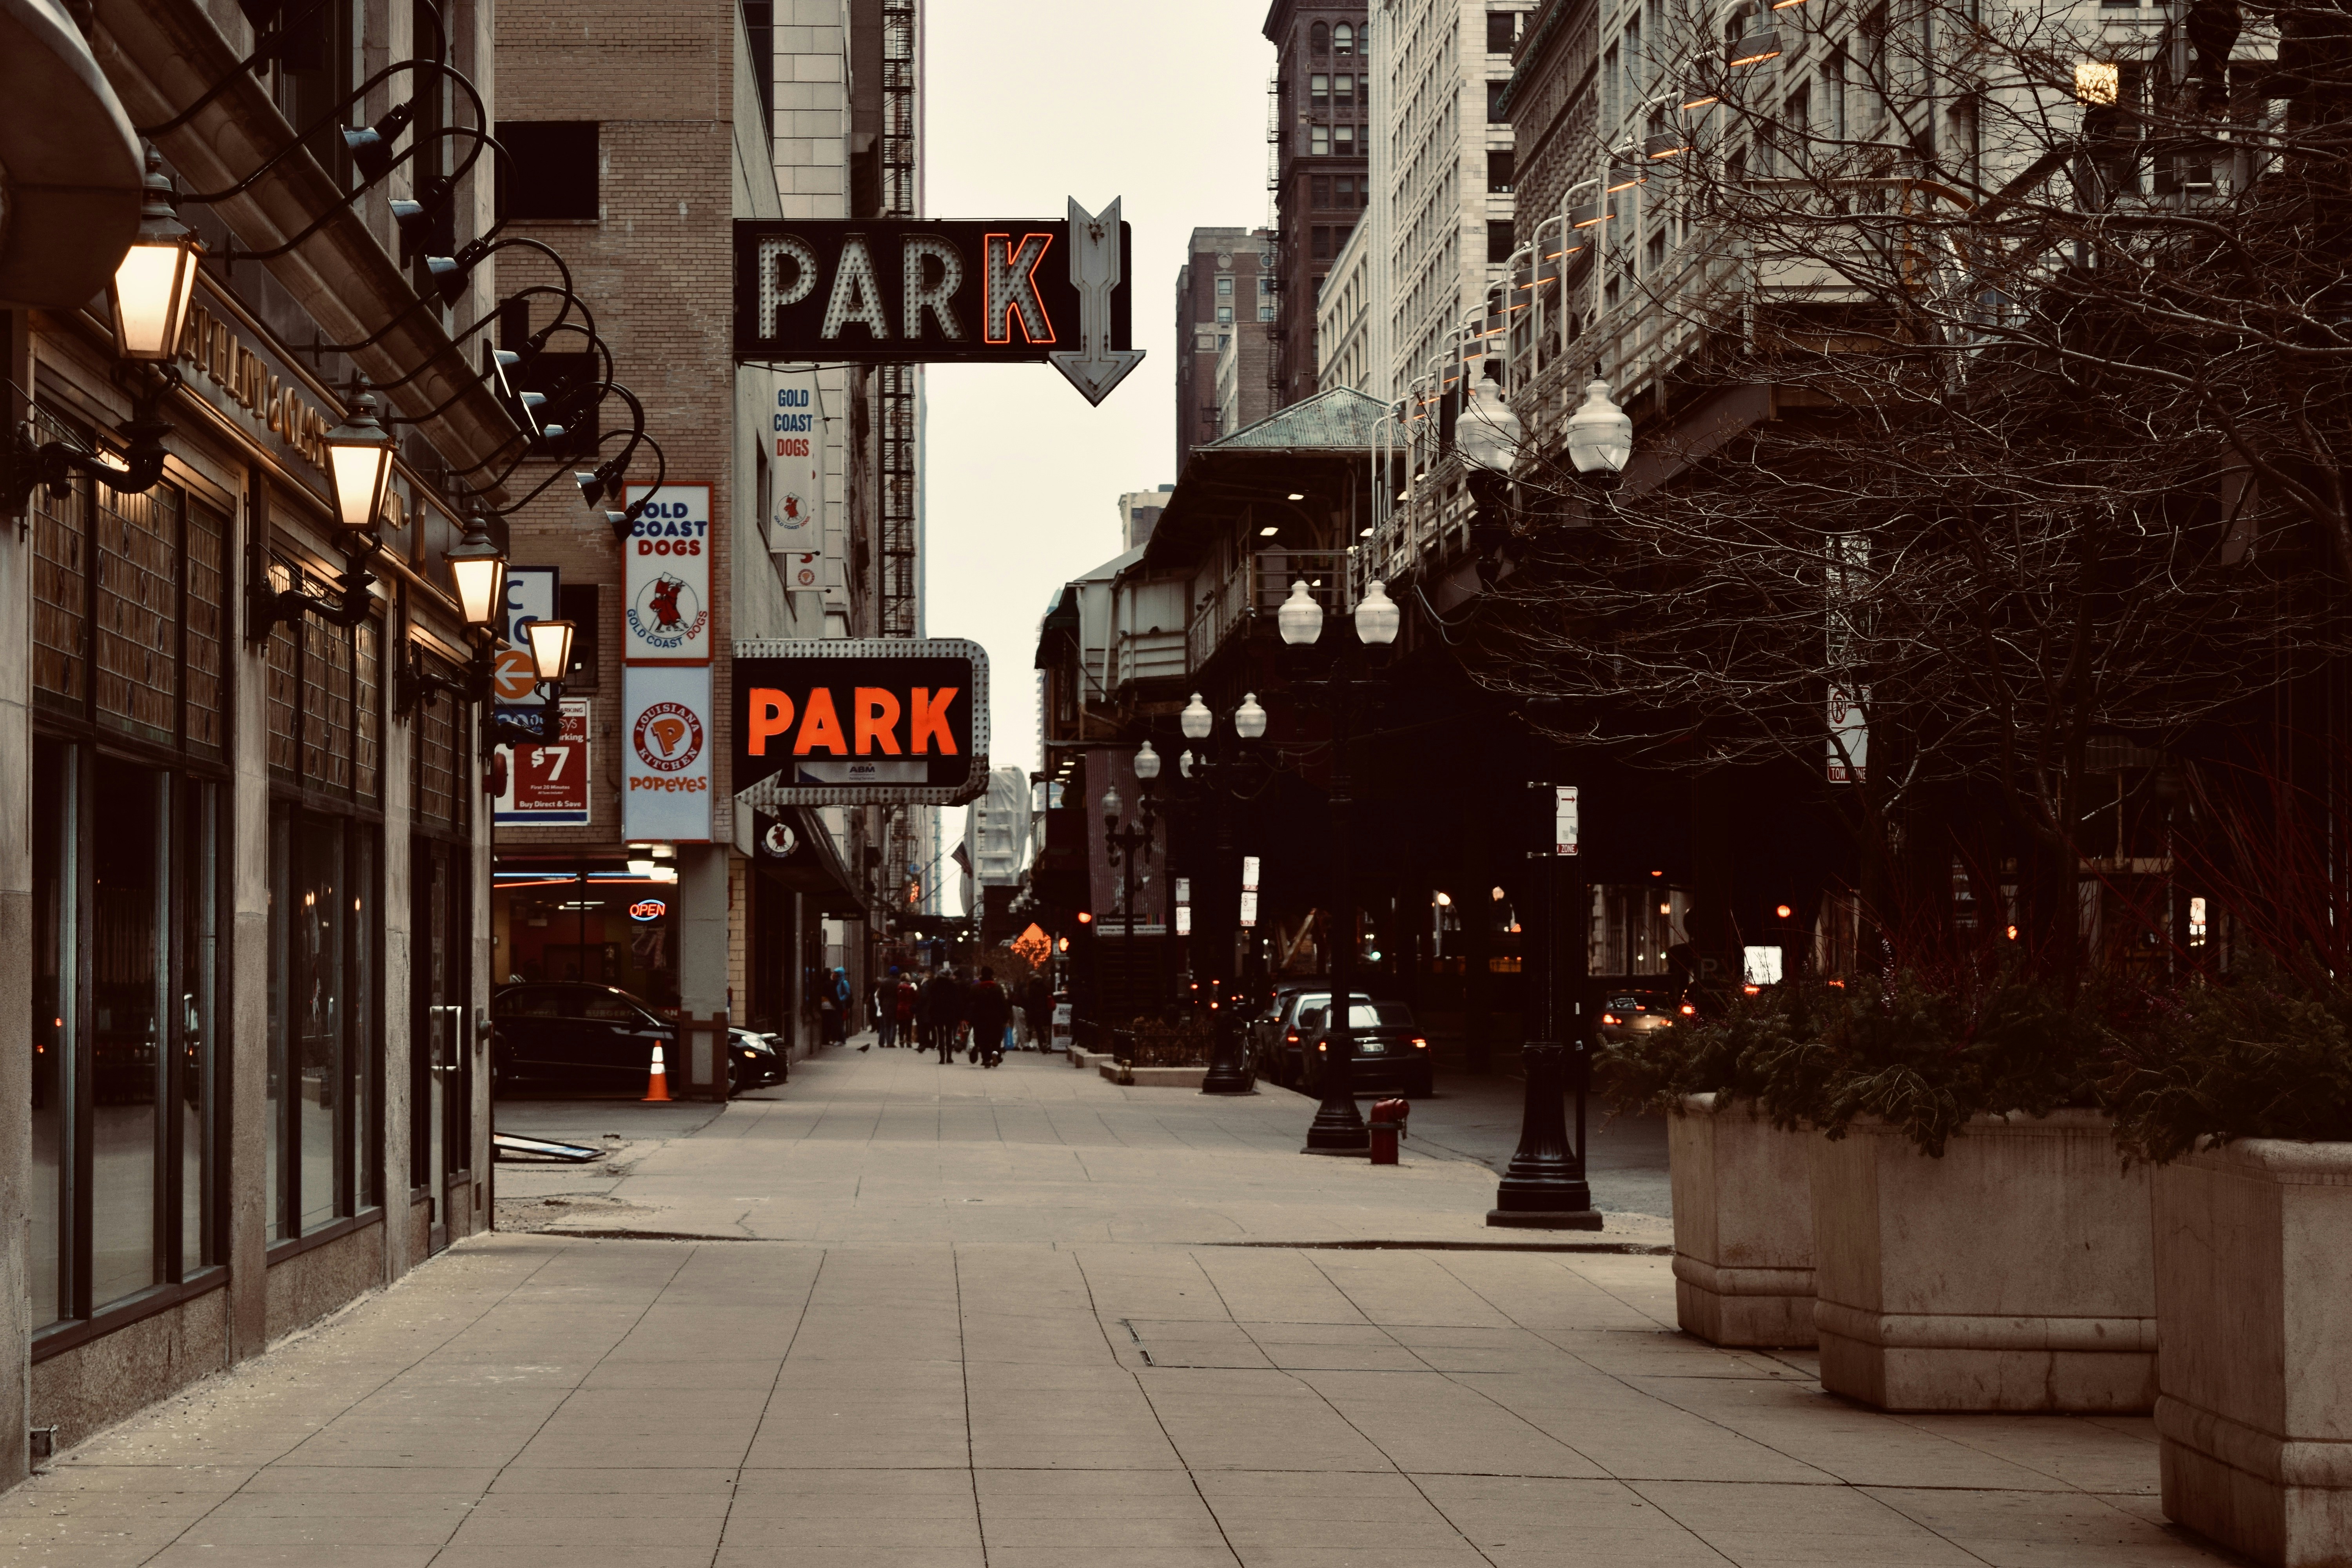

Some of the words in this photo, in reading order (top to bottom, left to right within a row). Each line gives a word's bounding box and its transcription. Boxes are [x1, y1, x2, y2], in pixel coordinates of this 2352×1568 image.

[756, 233, 1057, 344] PARK
[181, 296, 267, 419] EPHANT
[778, 389, 808, 407] GOLD
[774, 414, 813, 432] COAST
[777, 438, 809, 457] DOGS
[632, 521, 708, 537] COAST
[638, 539, 701, 556] DOGS
[626, 608, 647, 638] GOLD
[646, 635, 683, 649] COAST
[686, 610, 708, 640] DOGS
[636, 704, 700, 733] LOUISIANA
[748, 687, 959, 755] PARK
[559, 733, 583, 743] rking
[531, 746, 570, 781] $7
[639, 747, 698, 771] KITCHEN
[1831, 768, 1846, 779] TOW
[1561, 844, 1575, 853] ZONE
[630, 904, 666, 916] OPEN
